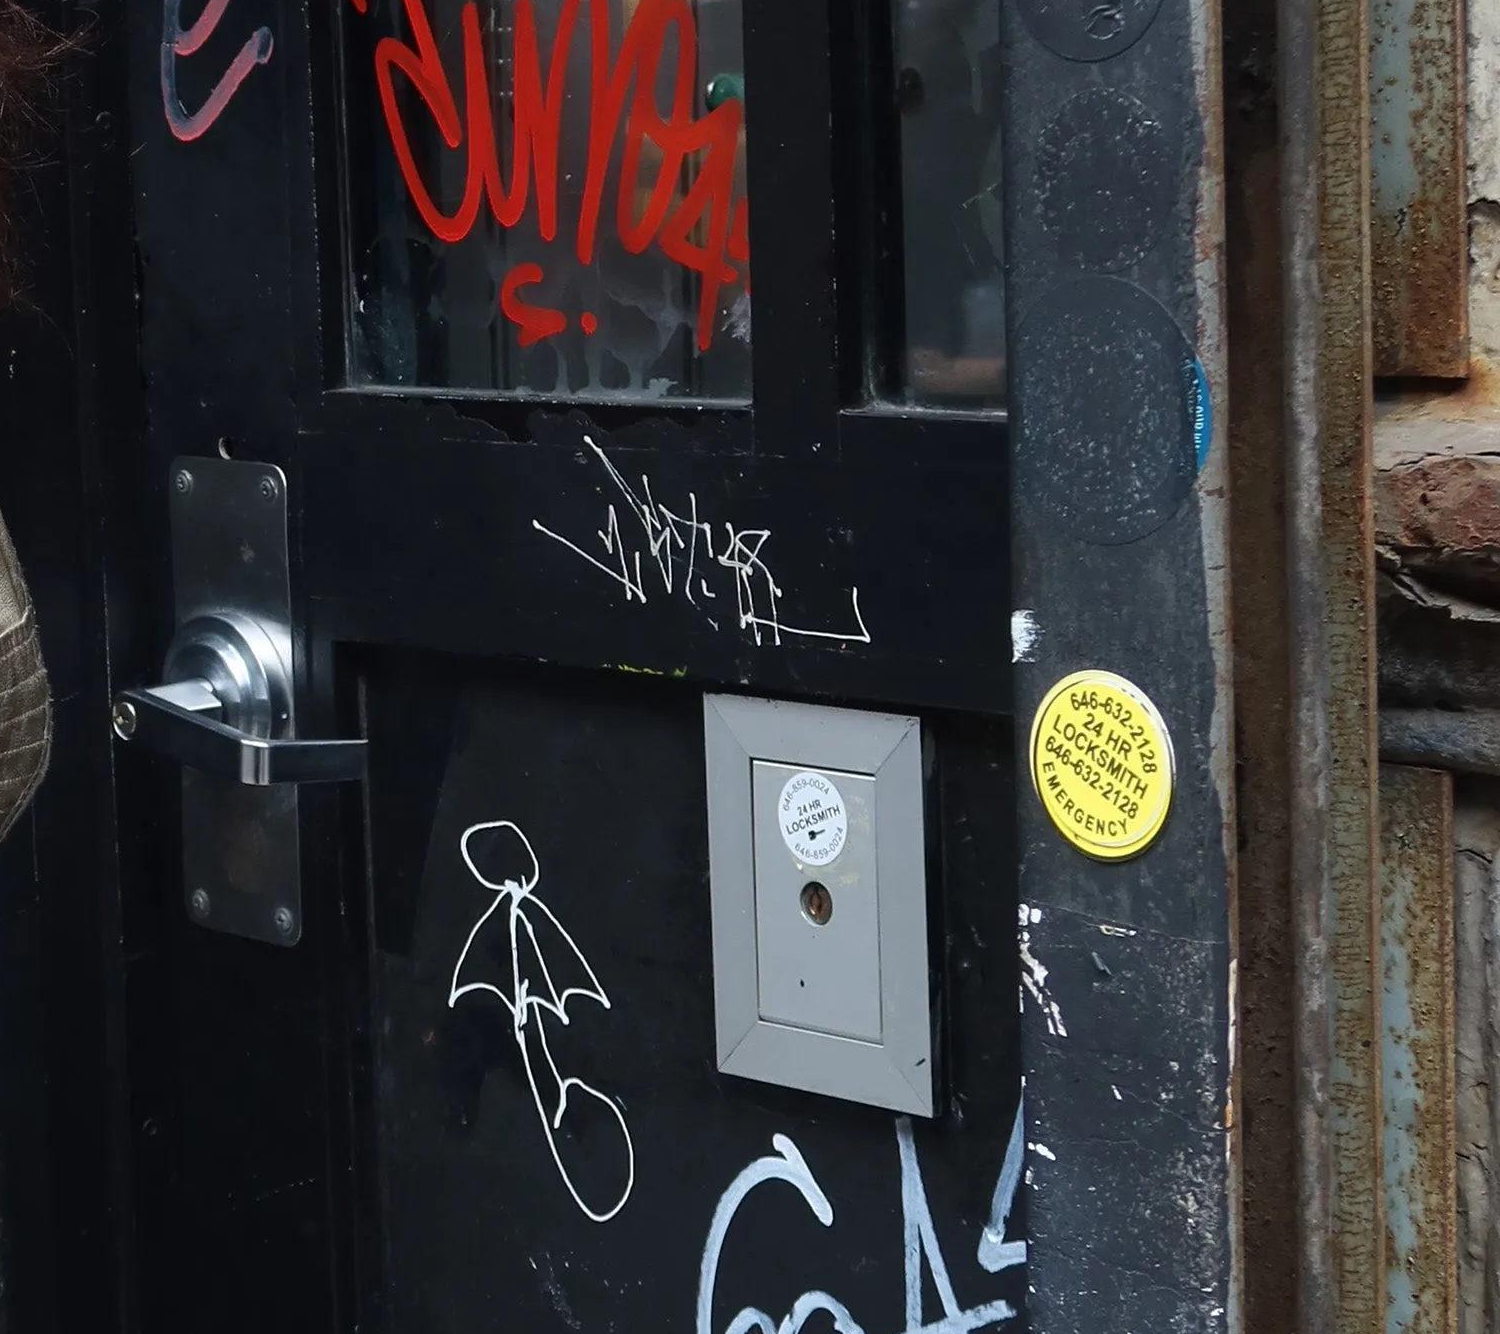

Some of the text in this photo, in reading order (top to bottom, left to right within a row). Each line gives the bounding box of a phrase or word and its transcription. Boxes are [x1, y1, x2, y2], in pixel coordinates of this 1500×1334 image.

[1052, 714, 1149, 799] LOCKSMITH
[1070, 690, 1158, 774] 646-632-2128
[1082, 712, 1132, 761] 24 HR
[797, 798, 823, 817] 24 HR
[1042, 761, 1129, 837] EMERGENCY
[1045, 735, 1139, 820] 646-632-2128
[785, 804, 841, 835] LOCKSMITH
